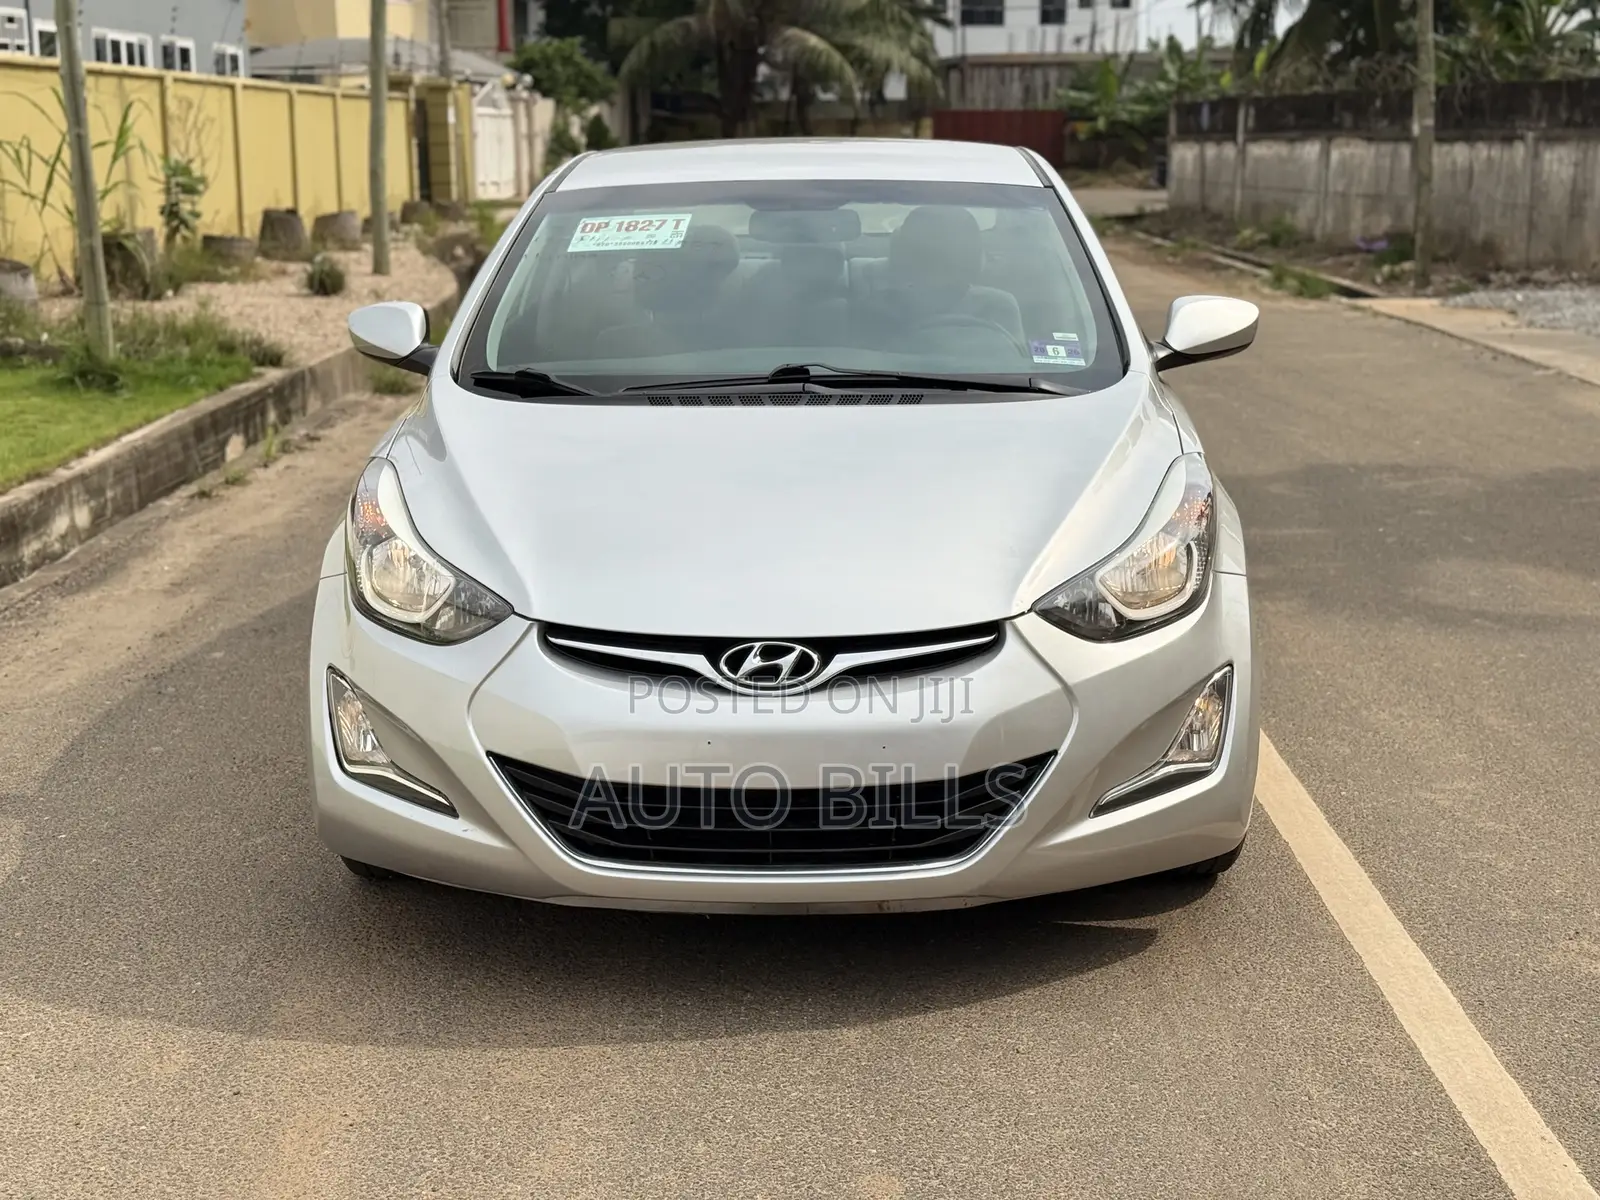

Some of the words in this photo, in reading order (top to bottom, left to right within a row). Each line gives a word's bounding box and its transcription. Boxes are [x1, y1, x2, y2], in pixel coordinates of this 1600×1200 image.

[616, 219, 668, 232] 1827
[672, 218, 686, 230] T
[1052, 347, 1060, 355] 6
